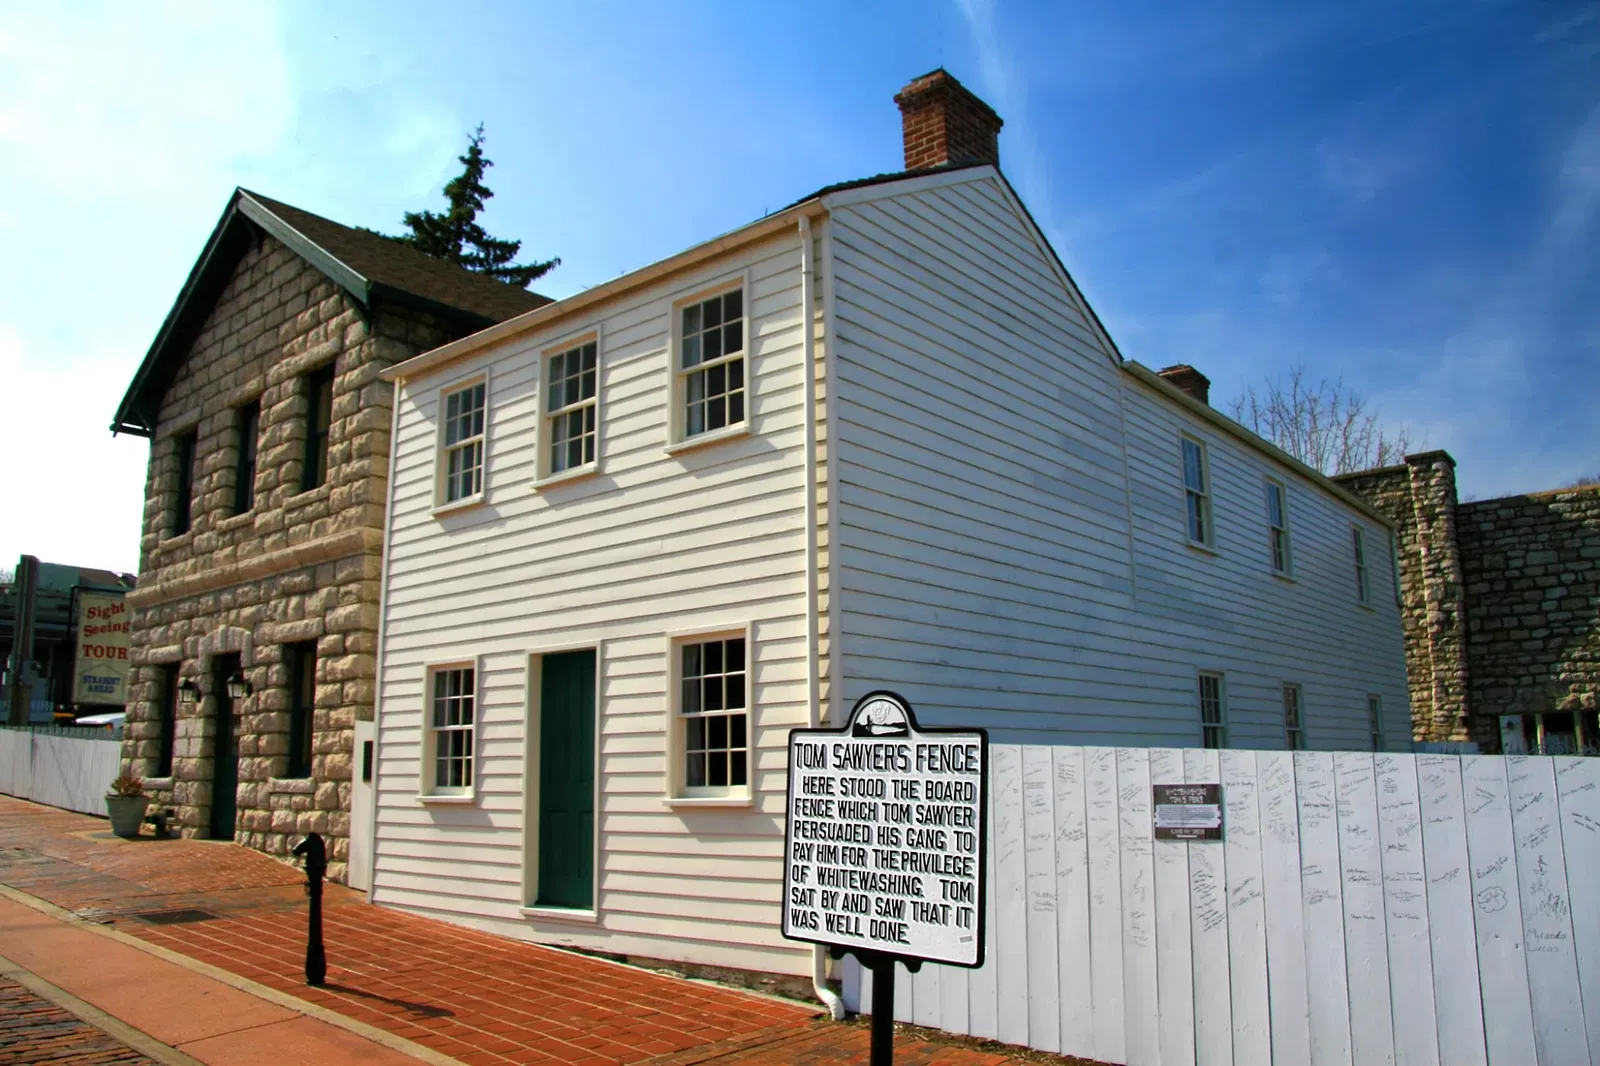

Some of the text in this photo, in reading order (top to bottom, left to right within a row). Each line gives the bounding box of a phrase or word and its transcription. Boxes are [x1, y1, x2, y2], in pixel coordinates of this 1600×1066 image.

[87, 602, 125, 619] Sight
[83, 621, 131, 638] Seeing
[82, 644, 128, 660] TOUR
[794, 743, 978, 773] TOM SAWYER'S FENCE
[802, 776, 973, 801] HERE STOOD THE BOARD
[794, 798, 973, 827] FENCE WHICH TOM SAWYER
[793, 820, 973, 851] PERSUADED HIS GANG TO
[792, 843, 973, 876] PAY HIM FOR THE PRIVILEGE
[791, 865, 809, 883] OF
[939, 879, 972, 902] TOM
[791, 886, 972, 928] SAT BY AND SAW THAT IT
[791, 908, 909, 943] WAS WELL DONE
